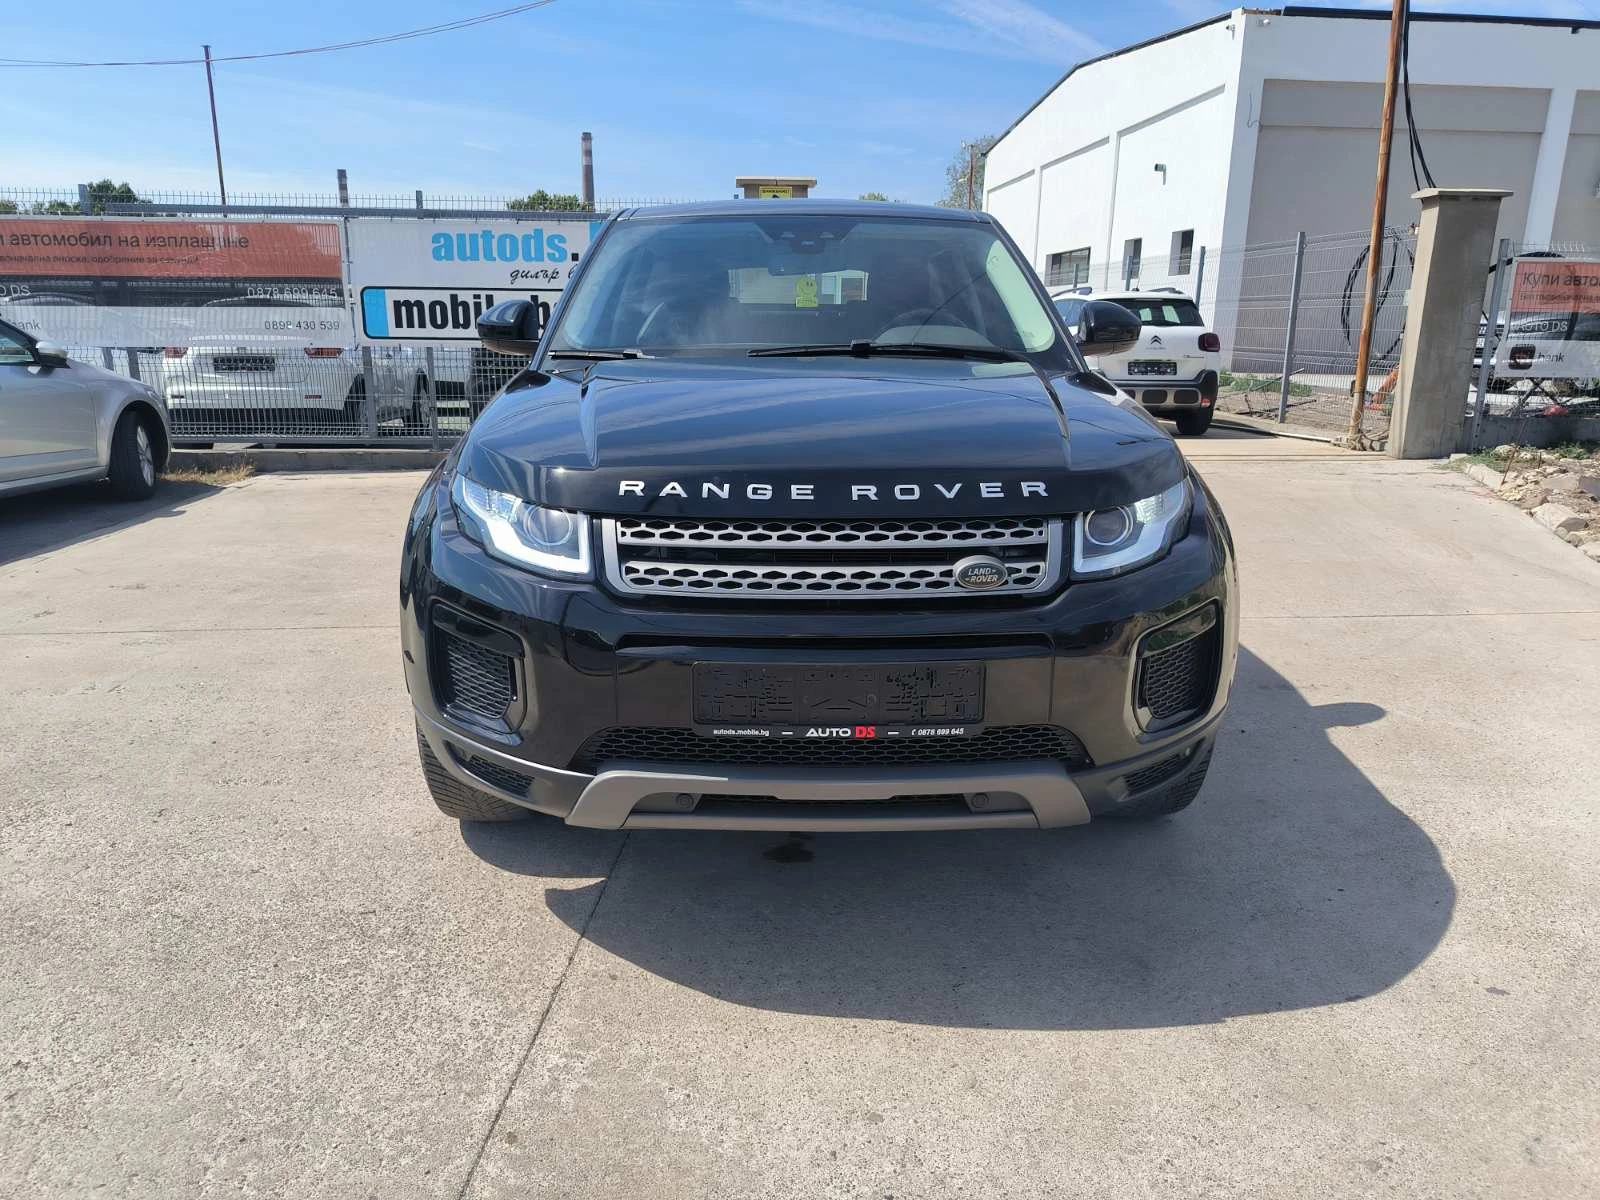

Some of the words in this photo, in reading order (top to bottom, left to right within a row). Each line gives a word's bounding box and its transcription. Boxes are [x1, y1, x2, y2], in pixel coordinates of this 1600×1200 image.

[9, 232, 112, 247] автомобил
[118, 236, 140, 248] на
[145, 235, 249, 249] изплащне
[1523, 272, 1560, 289] Купи
[1563, 275, 1600, 287] авто
[10, 285, 31, 296] DS
[247, 287, 279, 298] 0878
[312, 287, 338, 299] 645
[295, 320, 316, 330] 430
[319, 320, 340, 330] 539
[1552, 320, 1568, 332] DS
[618, 480, 815, 500] RANGE
[851, 481, 1049, 501] ROVER
[968, 567, 992, 576] LAND
[970, 574, 998, 583] ROVER
[805, 727, 851, 738] AUTO
[855, 726, 876, 738] DS
